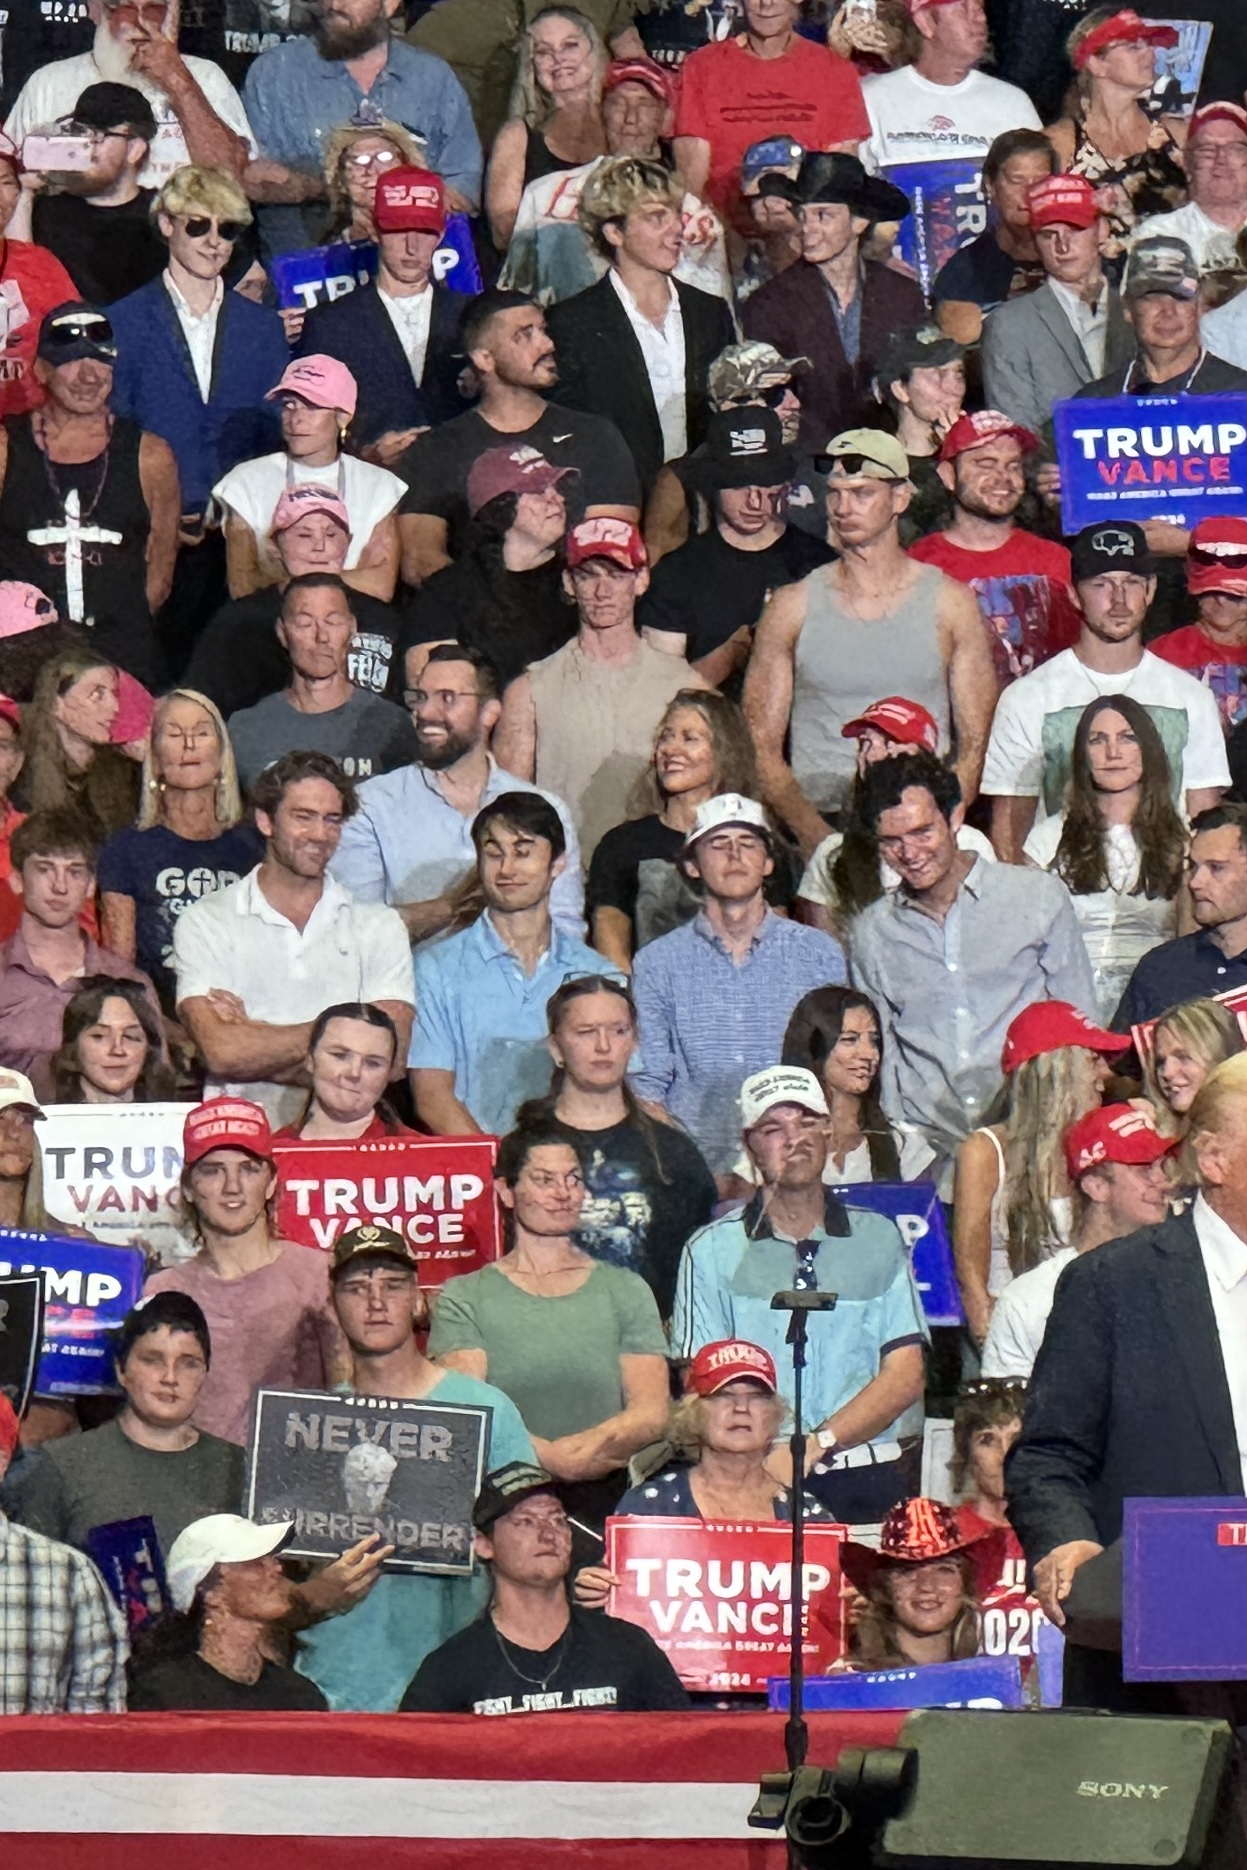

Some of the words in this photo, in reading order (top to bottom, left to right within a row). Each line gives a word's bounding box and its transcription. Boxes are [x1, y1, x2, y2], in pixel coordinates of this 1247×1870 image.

[1072, 422, 1247, 460] TRUMP
[1097, 457, 1231, 485] VANCE
[286, 1173, 484, 1216] TRUMP
[284, 1411, 454, 1463] NEVER
[625, 1558, 832, 1601] TRUMP
[1077, 1781, 1169, 1799] SONY
